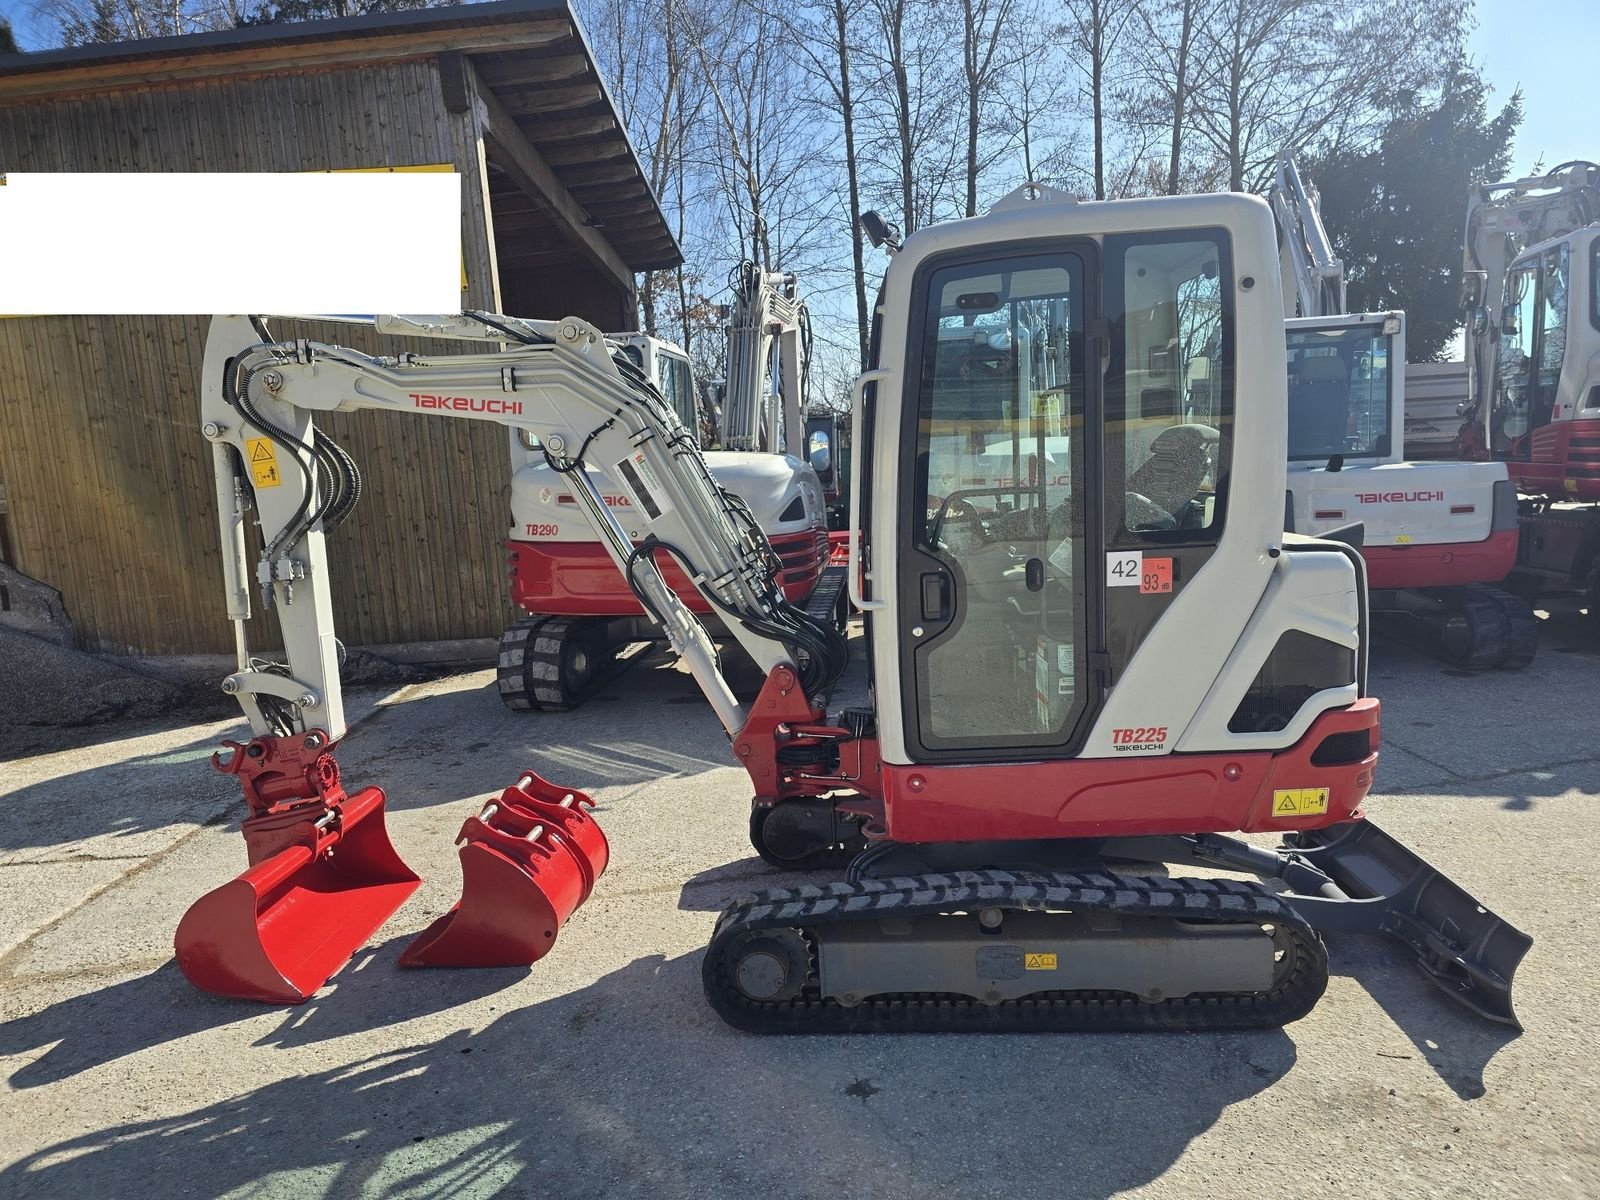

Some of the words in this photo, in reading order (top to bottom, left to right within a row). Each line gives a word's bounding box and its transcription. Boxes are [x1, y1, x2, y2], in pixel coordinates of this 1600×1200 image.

[526, 524, 559, 536] TB290
[1111, 559, 1138, 578] 42
[1143, 573, 1159, 591] 93
[1161, 582, 1170, 590] dB
[1112, 727, 1168, 744] TB225
